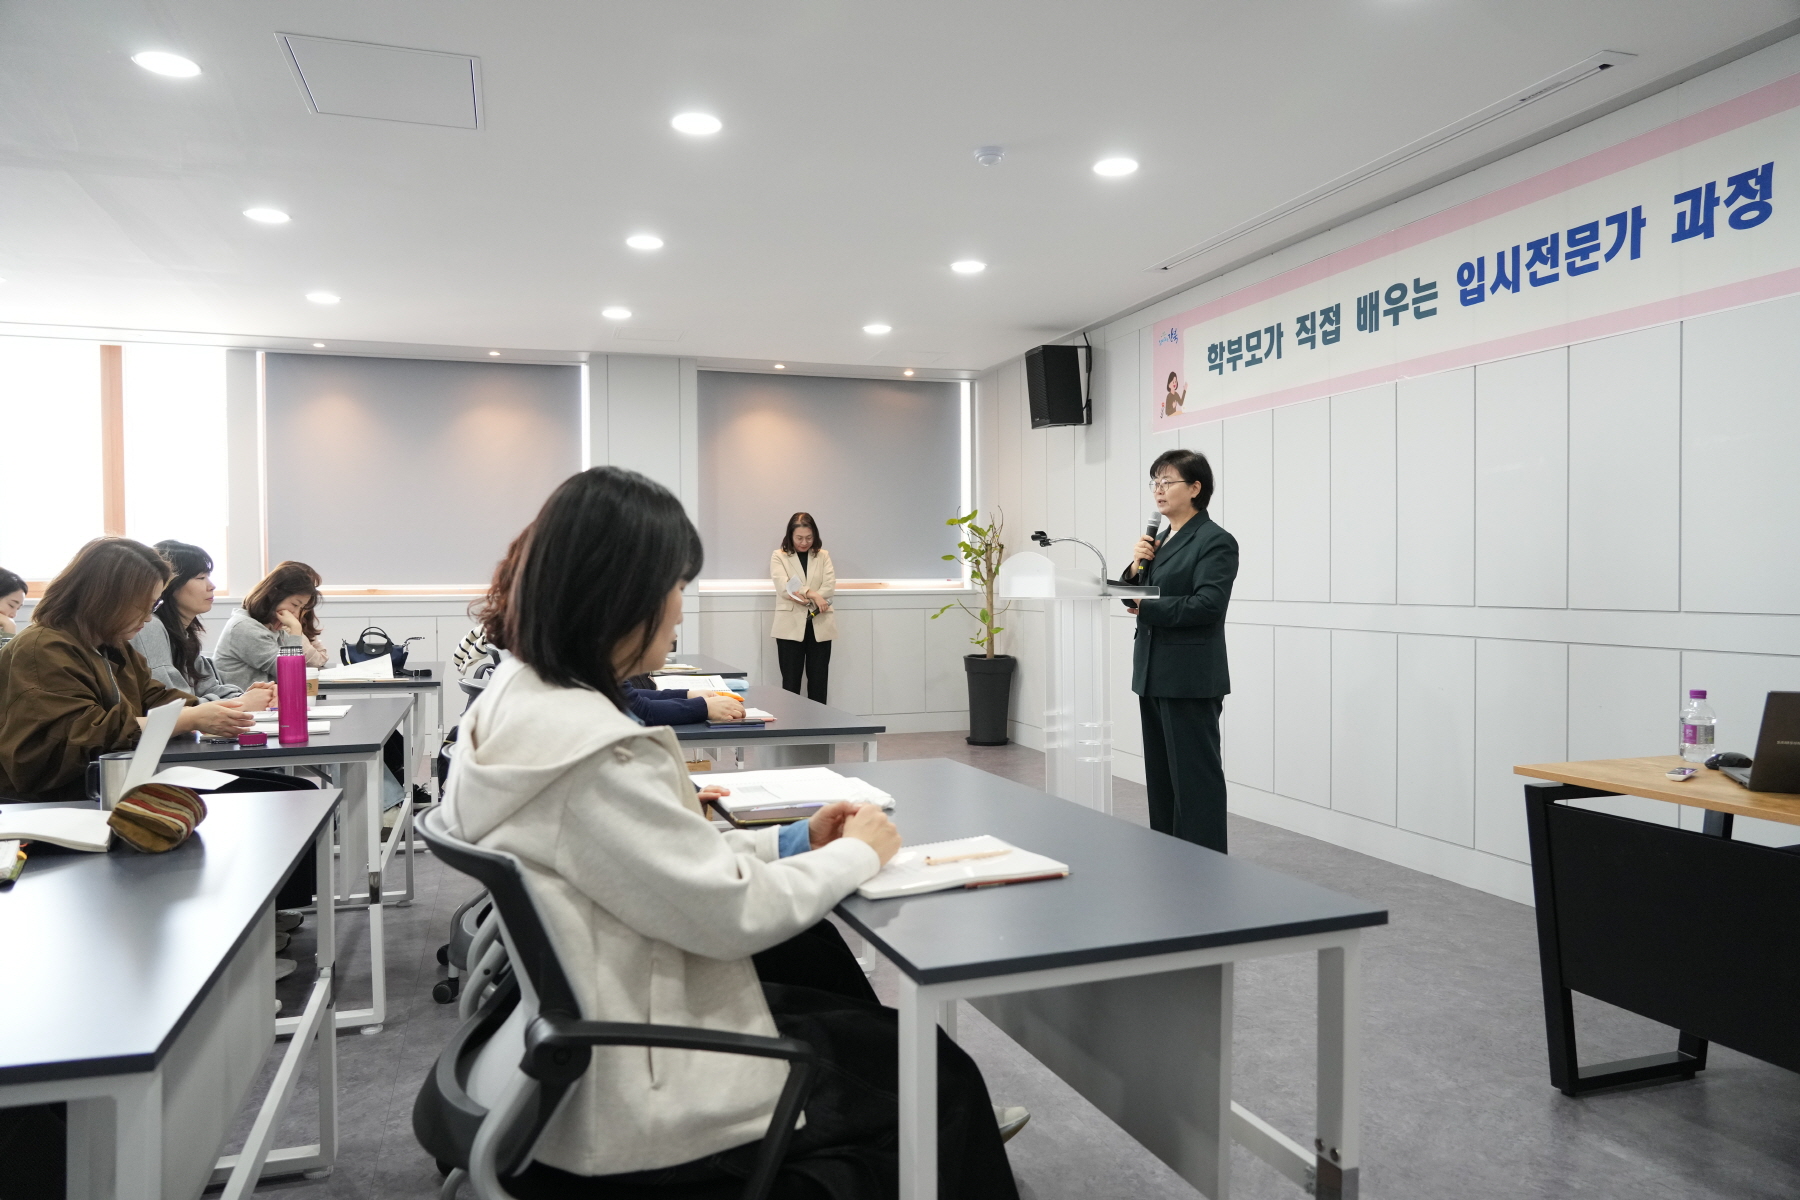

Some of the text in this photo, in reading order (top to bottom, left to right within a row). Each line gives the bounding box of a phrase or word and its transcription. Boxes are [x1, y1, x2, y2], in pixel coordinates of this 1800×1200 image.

[1207, 160, 1775, 376] 학부모가 직접 배우는 입시전문가 과정
